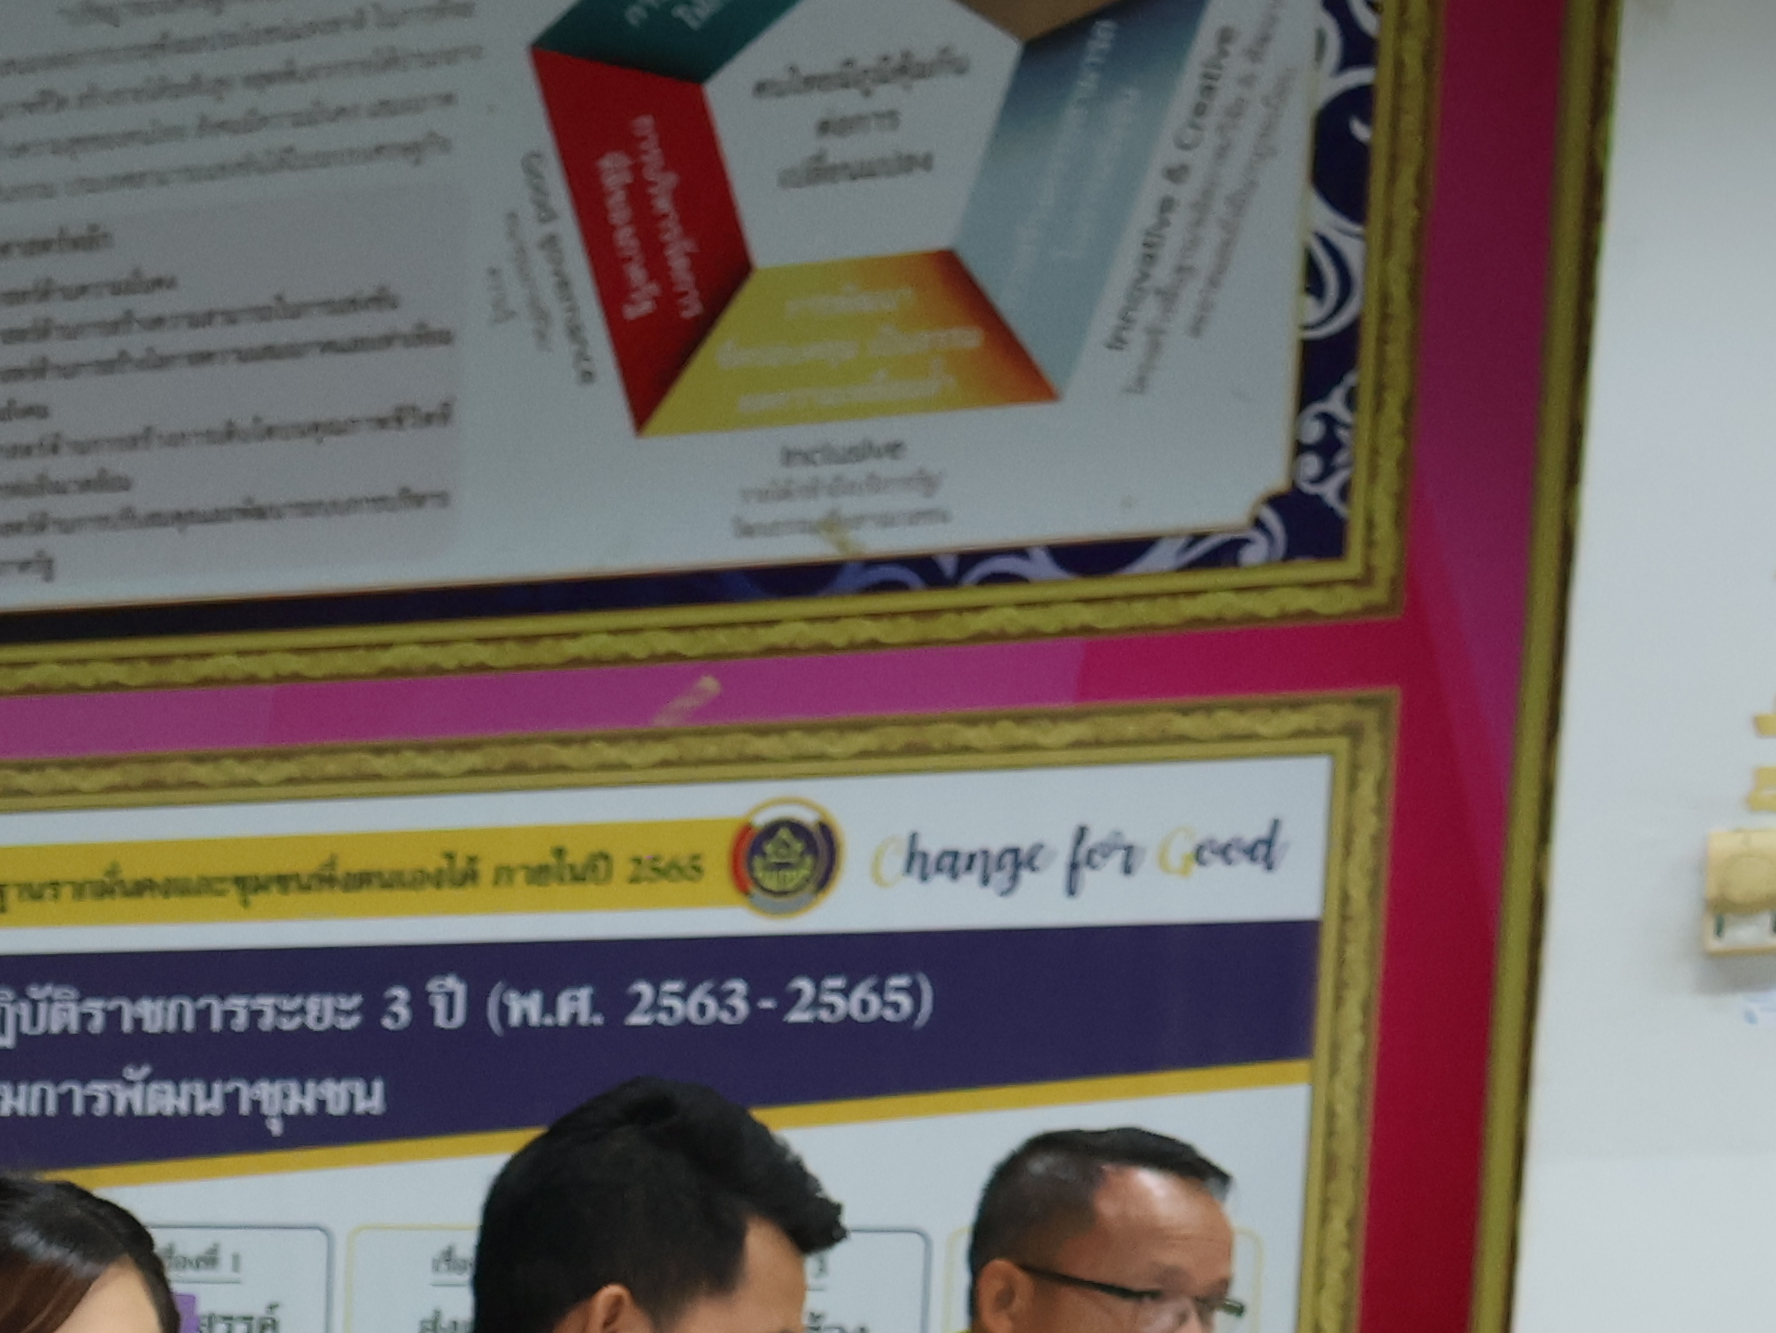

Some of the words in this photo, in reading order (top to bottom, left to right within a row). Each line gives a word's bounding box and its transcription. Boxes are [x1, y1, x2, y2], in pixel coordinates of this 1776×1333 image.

[870, 830, 1049, 898] Change
[1064, 824, 1140, 898] for
[1157, 817, 1286, 878] Good
[380, 986, 412, 1032] 3
[425, 972, 468, 1031] ปี
